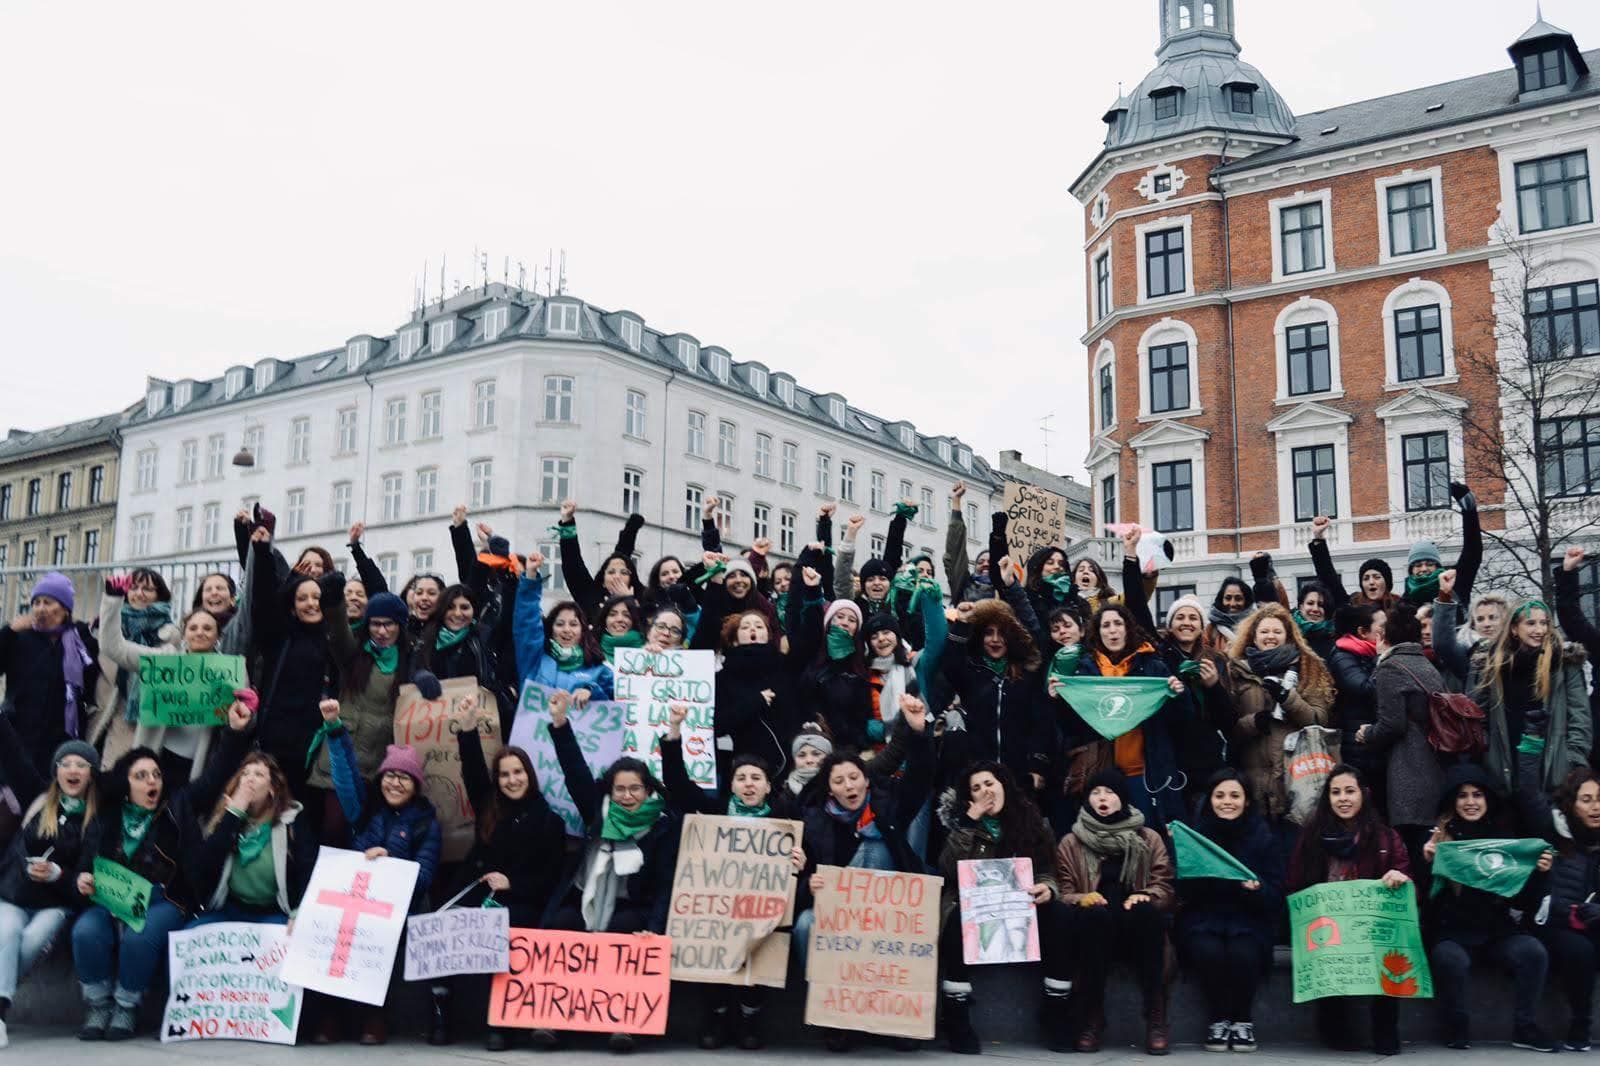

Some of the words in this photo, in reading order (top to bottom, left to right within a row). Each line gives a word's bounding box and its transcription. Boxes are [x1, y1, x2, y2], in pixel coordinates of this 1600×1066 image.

[1015, 486, 1047, 510] Somos
[618, 650, 683, 677] SOMOS
[616, 677, 638, 700] EL
[400, 699, 448, 745] 137
[591, 704, 623, 733] 23
[686, 822, 705, 851] IN
[714, 826, 796, 857] MEXICO
[677, 857, 694, 888] A
[702, 859, 791, 891] WOMAN
[674, 892, 730, 916] GETS
[671, 918, 733, 940] EVERY
[818, 904, 887, 932] WOMEN
[894, 910, 926, 934] DIE
[508, 936, 598, 976] SMASH
[609, 943, 662, 976] THE
[816, 936, 862, 952] EVERY
[872, 940, 904, 956] YEAR
[910, 943, 934, 958] FOR
[840, 961, 909, 985] UNSAFE
[502, 979, 663, 1029] PATRIARCHY
[823, 987, 924, 1018] ABORTION
[189, 1018, 219, 1037] NO
